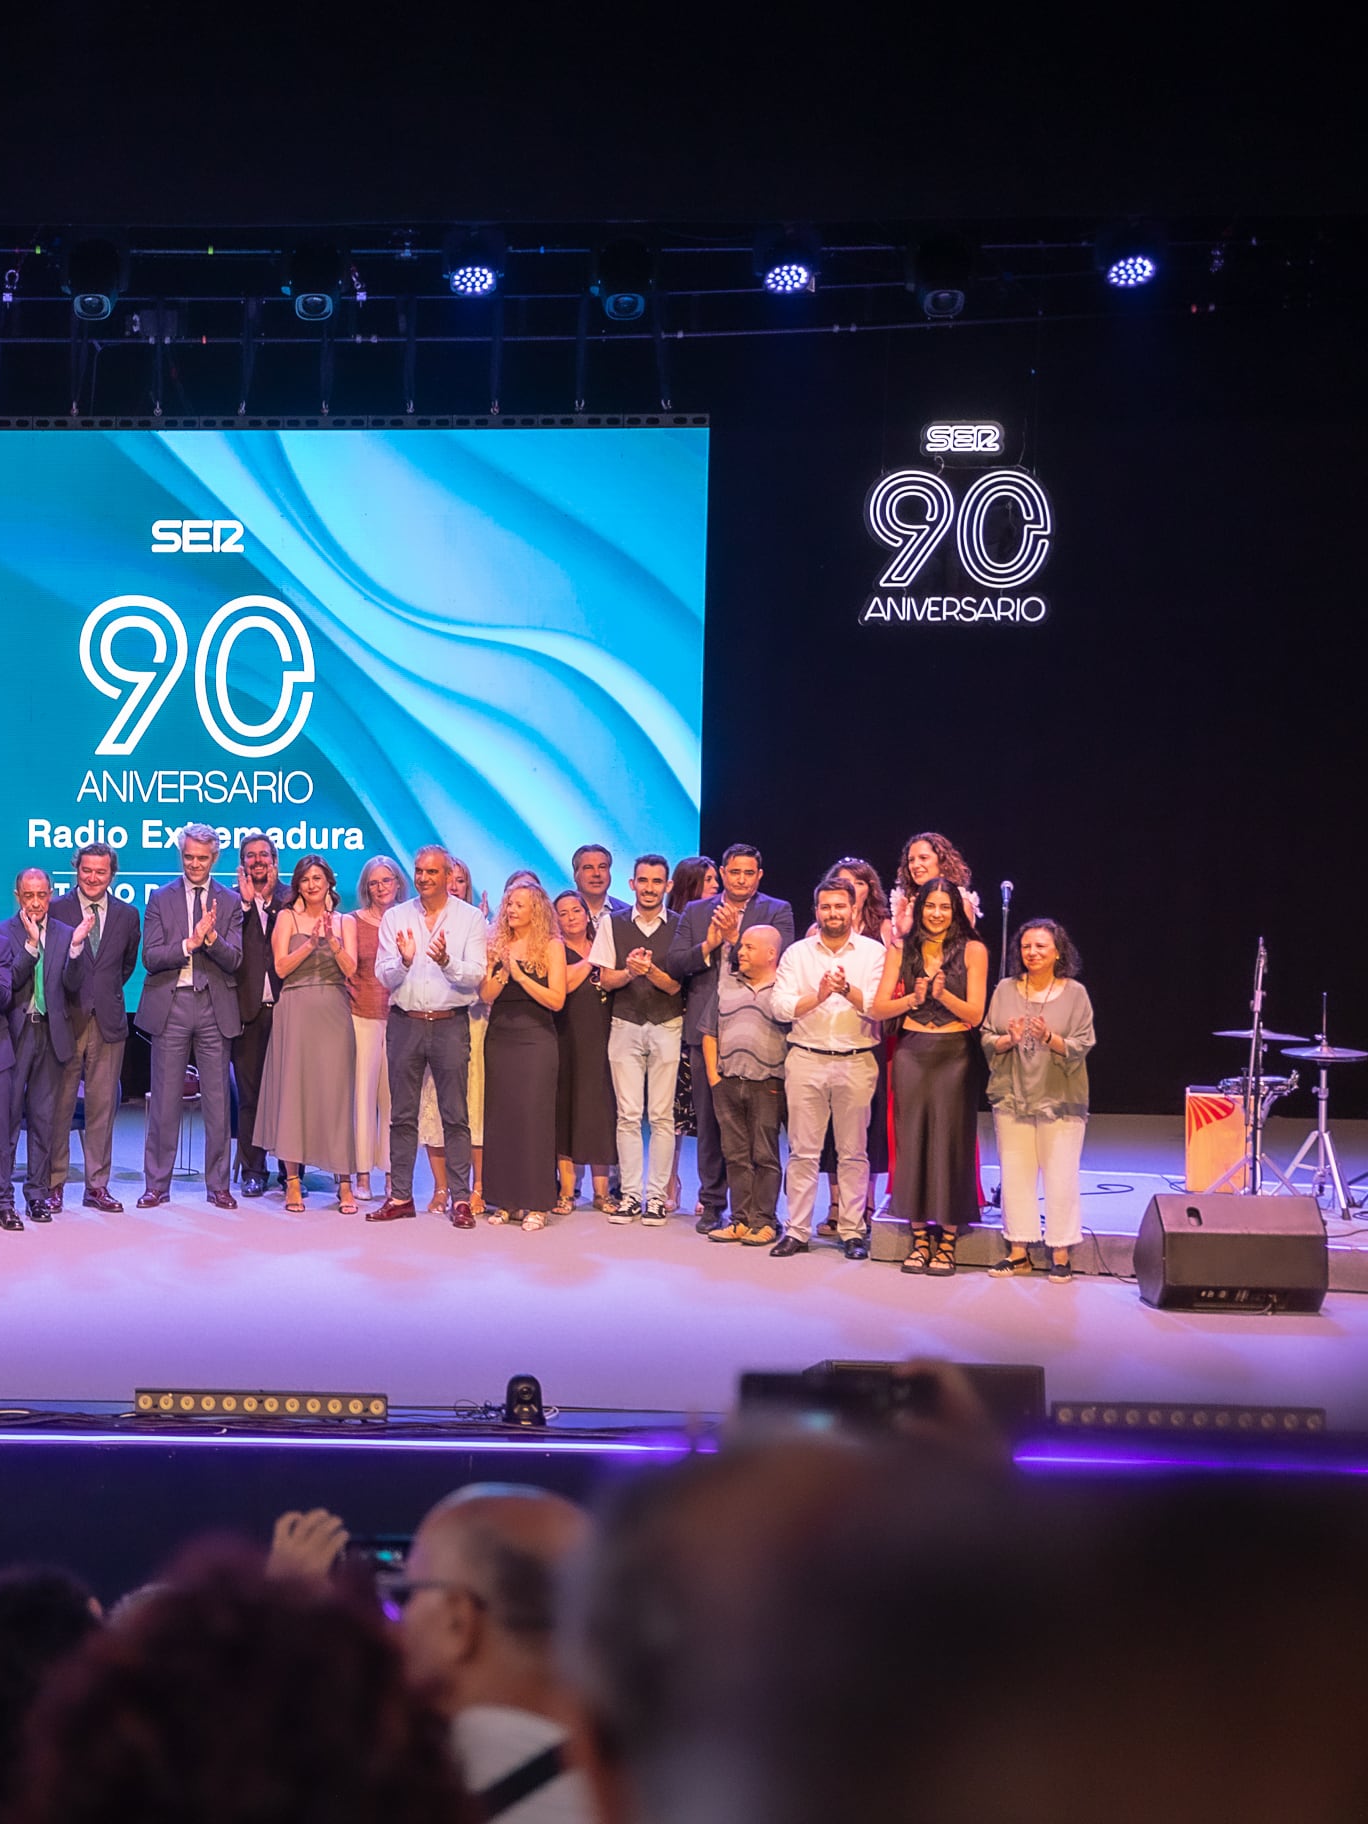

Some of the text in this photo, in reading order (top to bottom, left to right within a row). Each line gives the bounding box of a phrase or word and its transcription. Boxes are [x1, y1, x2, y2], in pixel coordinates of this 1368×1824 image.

[925, 424, 1001, 452] SER
[151, 519, 245, 553] SER
[869, 469, 1052, 589] 90
[863, 596, 1047, 623] ANIVERSARIO
[78, 594, 316, 759] 90
[76, 769, 315, 804] ANIVERSARIO
[28, 818, 128, 849] Radio
